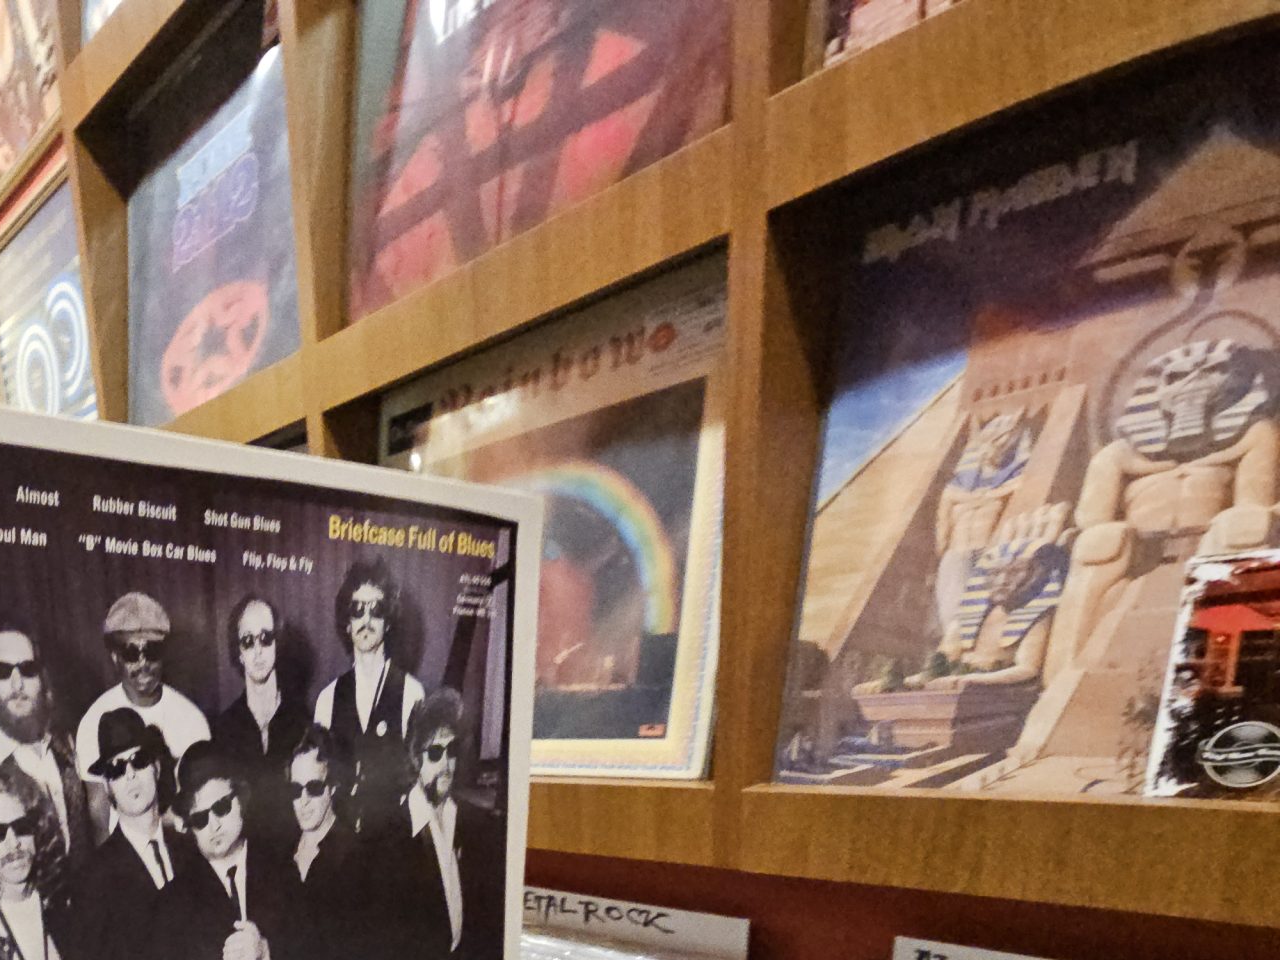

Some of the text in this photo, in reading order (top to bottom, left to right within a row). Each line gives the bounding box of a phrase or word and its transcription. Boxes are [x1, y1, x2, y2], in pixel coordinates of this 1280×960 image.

[16, 485, 60, 507] Almost
[93, 495, 177, 521] Rubber Biscuit
[204, 509, 280, 533] Shot Gun Blues
[20, 528, 48, 547] Man
[329, 514, 496, 559] Briefcase Full of Blues
[105, 537, 139, 556] Movie
[142, 540, 163, 558] Box
[165, 542, 185, 560] Car
[187, 545, 216, 563] Blues
[267, 553, 288, 572] Flop
[289, 555, 297, 571] &
[299, 556, 313, 575] Fly
[523, 890, 577, 928] ETAL
